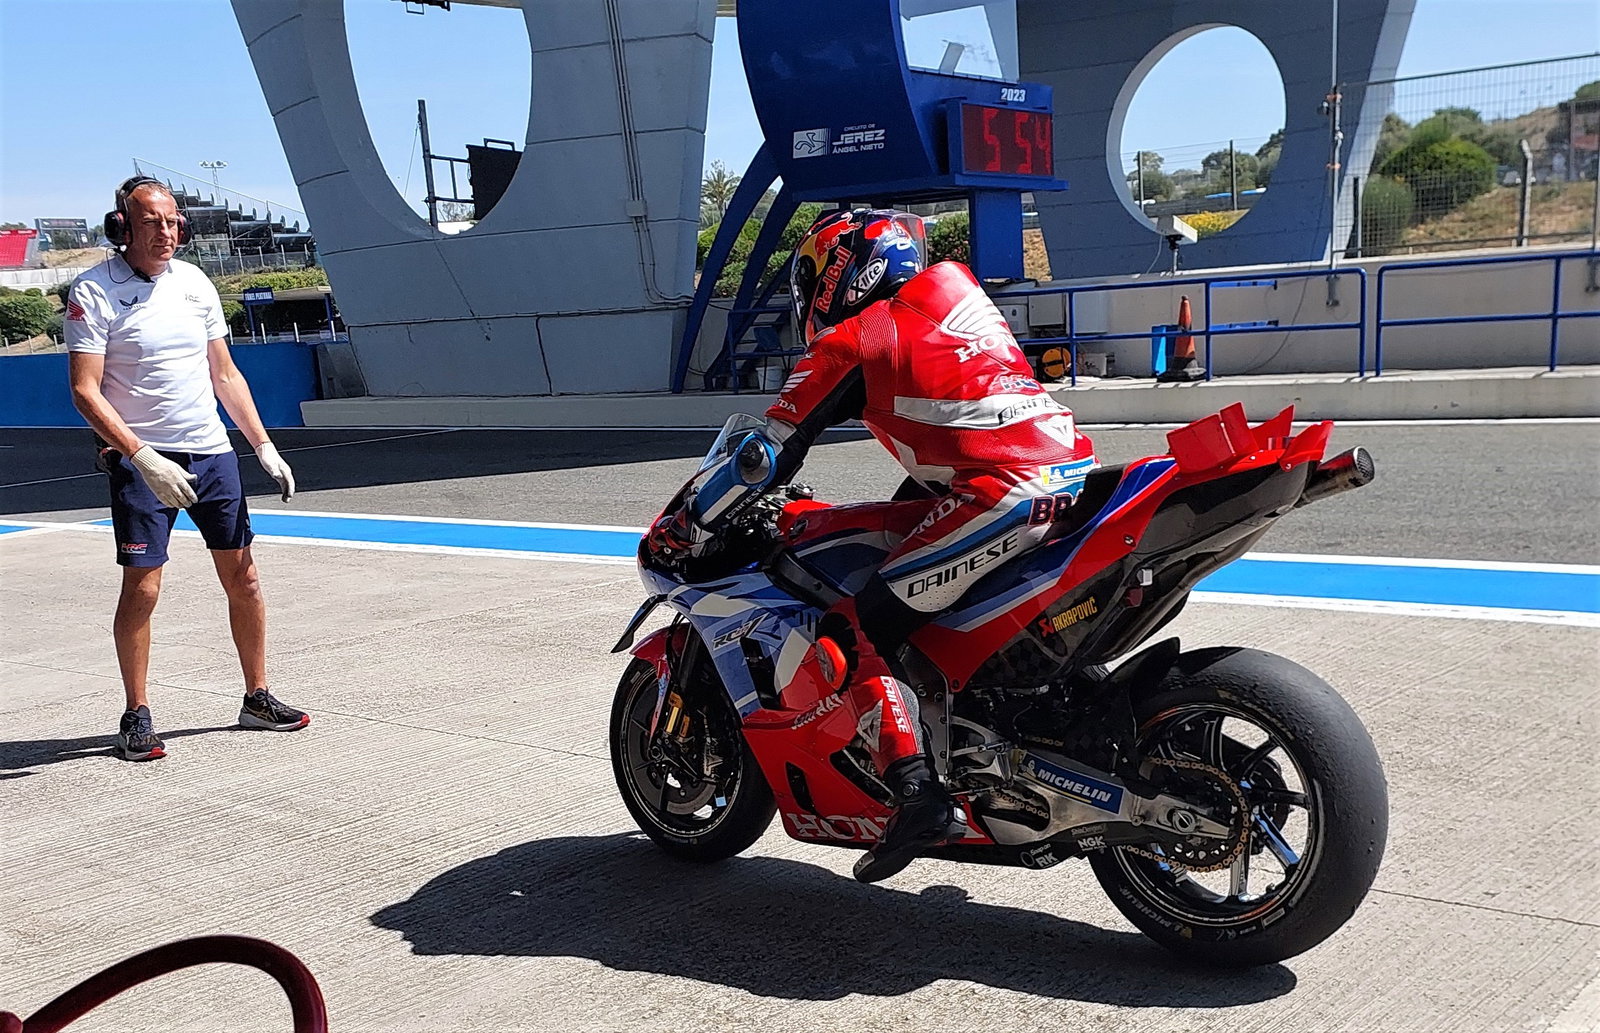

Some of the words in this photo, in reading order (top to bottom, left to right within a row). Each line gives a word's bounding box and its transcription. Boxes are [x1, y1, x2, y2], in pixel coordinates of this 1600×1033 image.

[1001, 88, 1026, 102] 2023
[844, 124, 867, 132] CIRCUITO
[832, 129, 885, 146] JEREZ
[860, 142, 884, 151] NIETO
[816, 275, 836, 313] Red
[826, 245, 853, 283] Bull
[907, 531, 1018, 598] DAINESE
[880, 675, 910, 734] DAINESE
[1037, 769, 1112, 802] MICHELIN
[1078, 835, 1105, 849] NGK
[1035, 852, 1059, 867] RK
